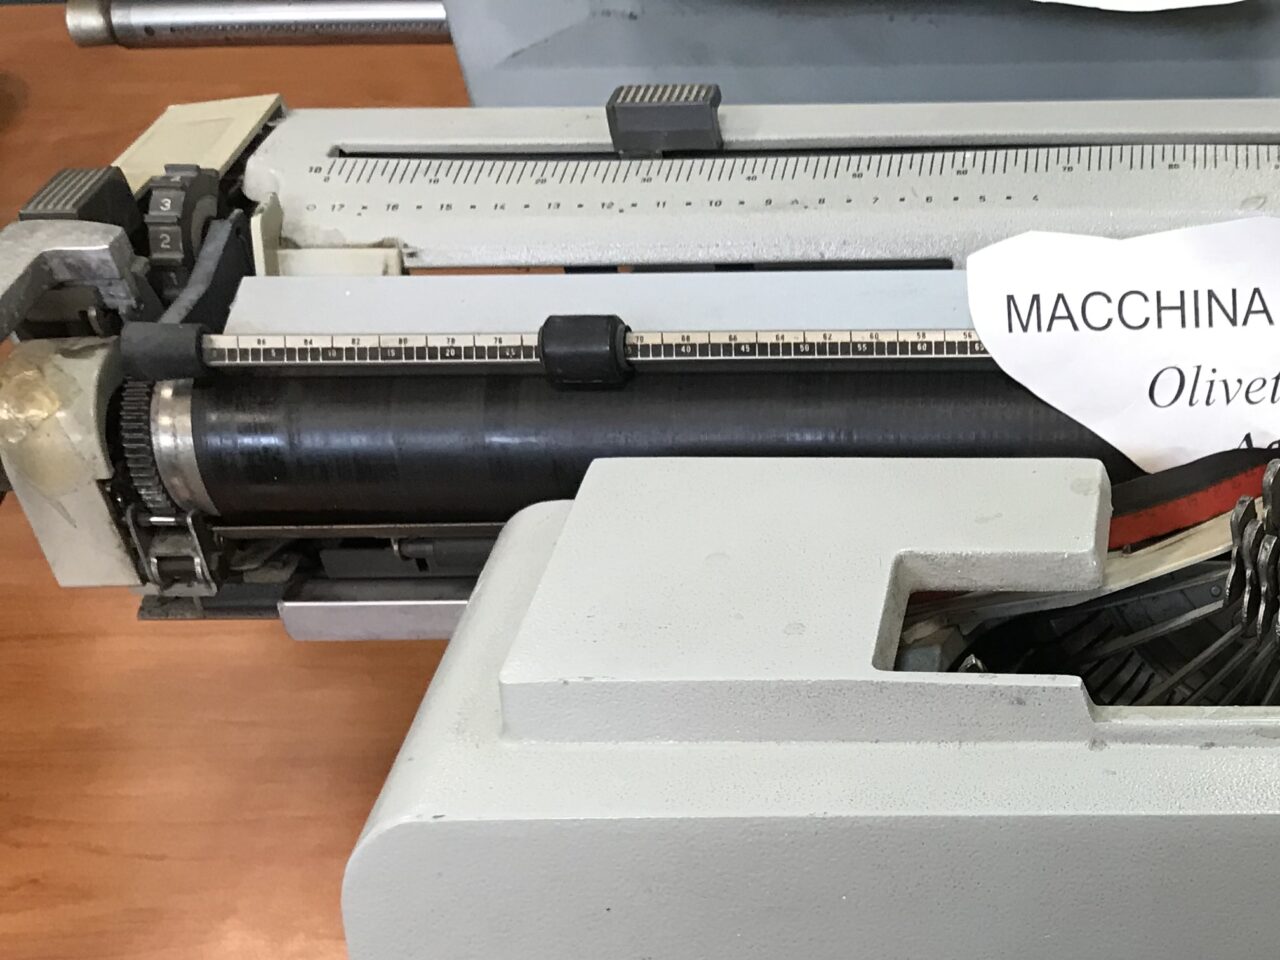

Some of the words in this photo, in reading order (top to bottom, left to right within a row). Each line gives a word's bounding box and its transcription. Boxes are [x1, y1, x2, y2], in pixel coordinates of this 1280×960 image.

[160, 198, 172, 211] 3
[159, 234, 171, 249] 2
[1006, 286, 1274, 333] MACCHINA
